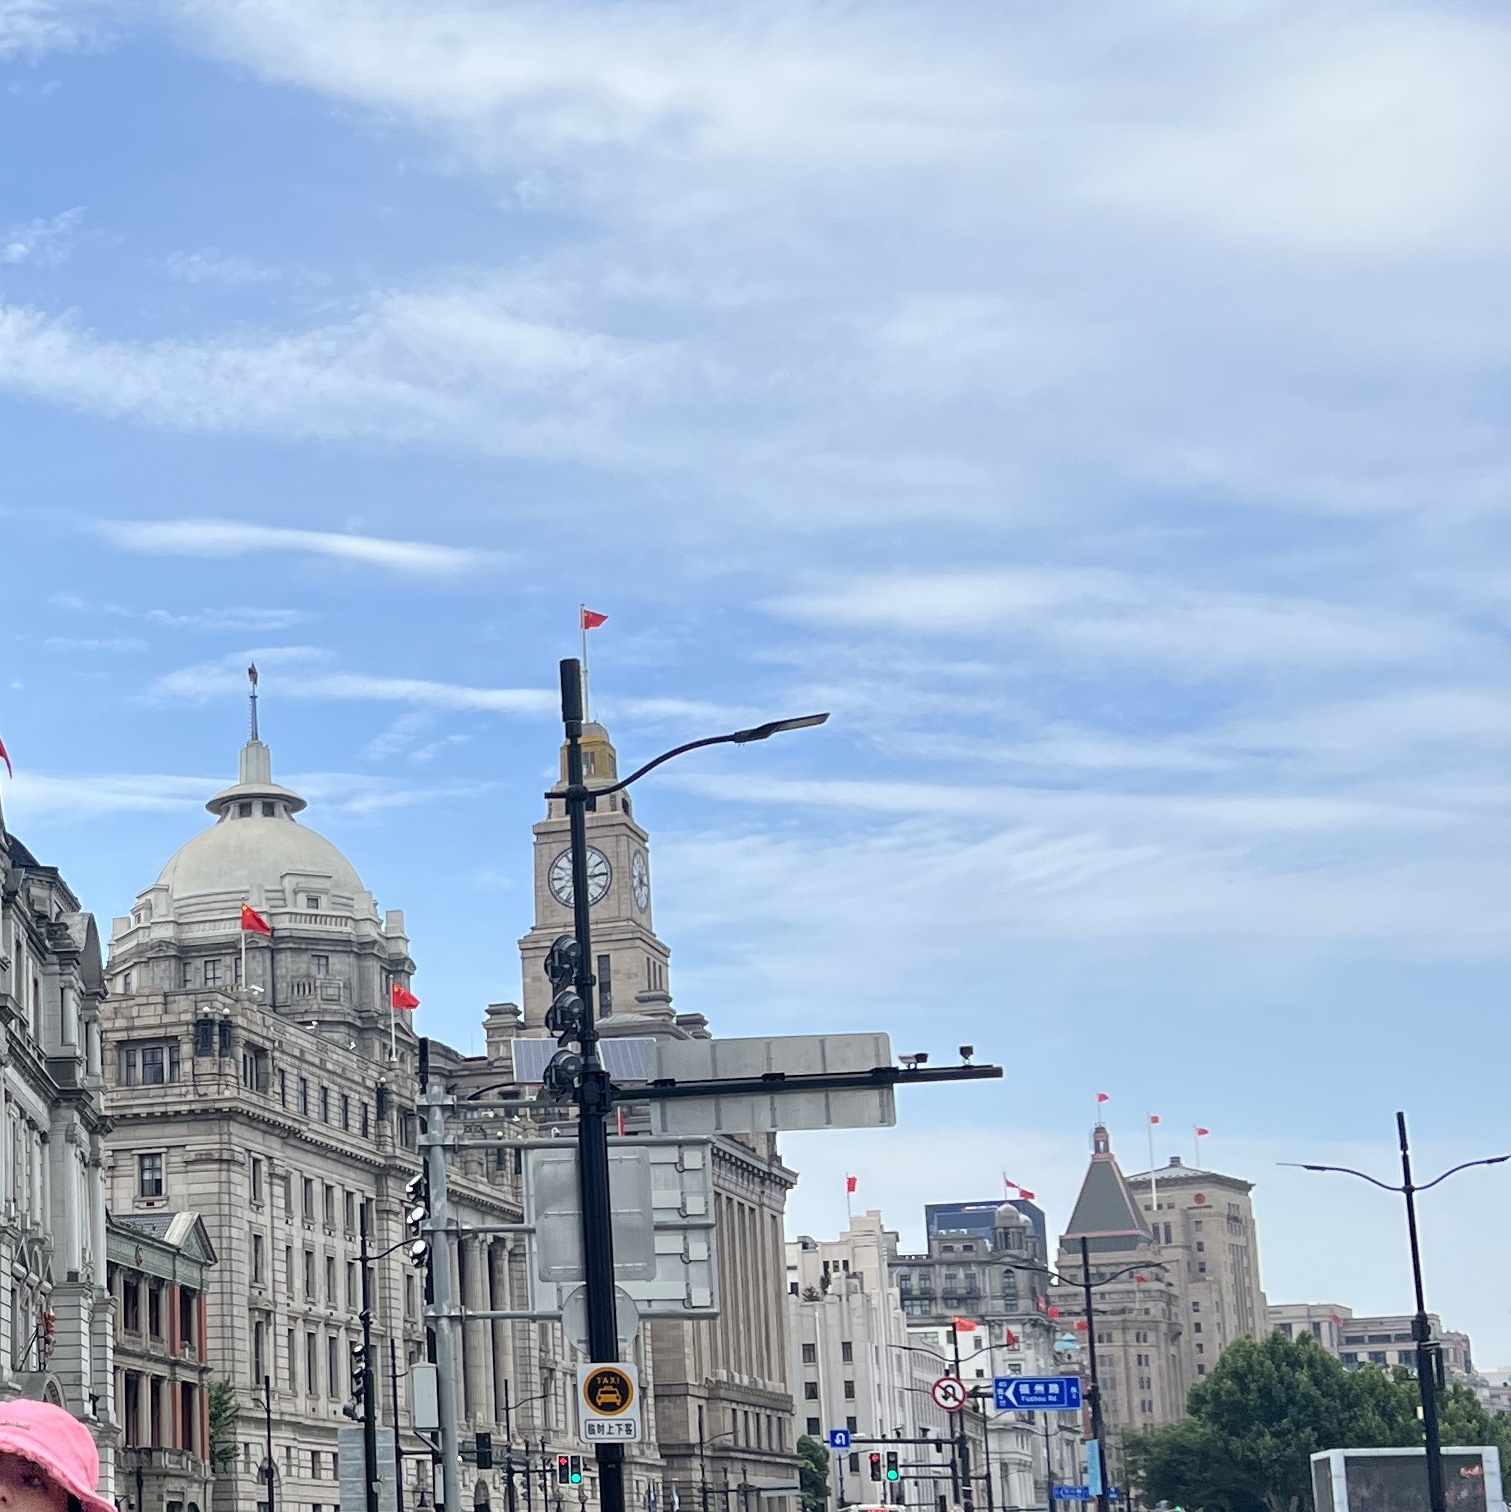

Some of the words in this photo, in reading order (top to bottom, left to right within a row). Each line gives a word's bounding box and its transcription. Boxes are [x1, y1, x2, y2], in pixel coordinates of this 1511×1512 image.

[596, 1376, 621, 1385] TAXI
[587, 1423, 633, 1436] 临时上下客
